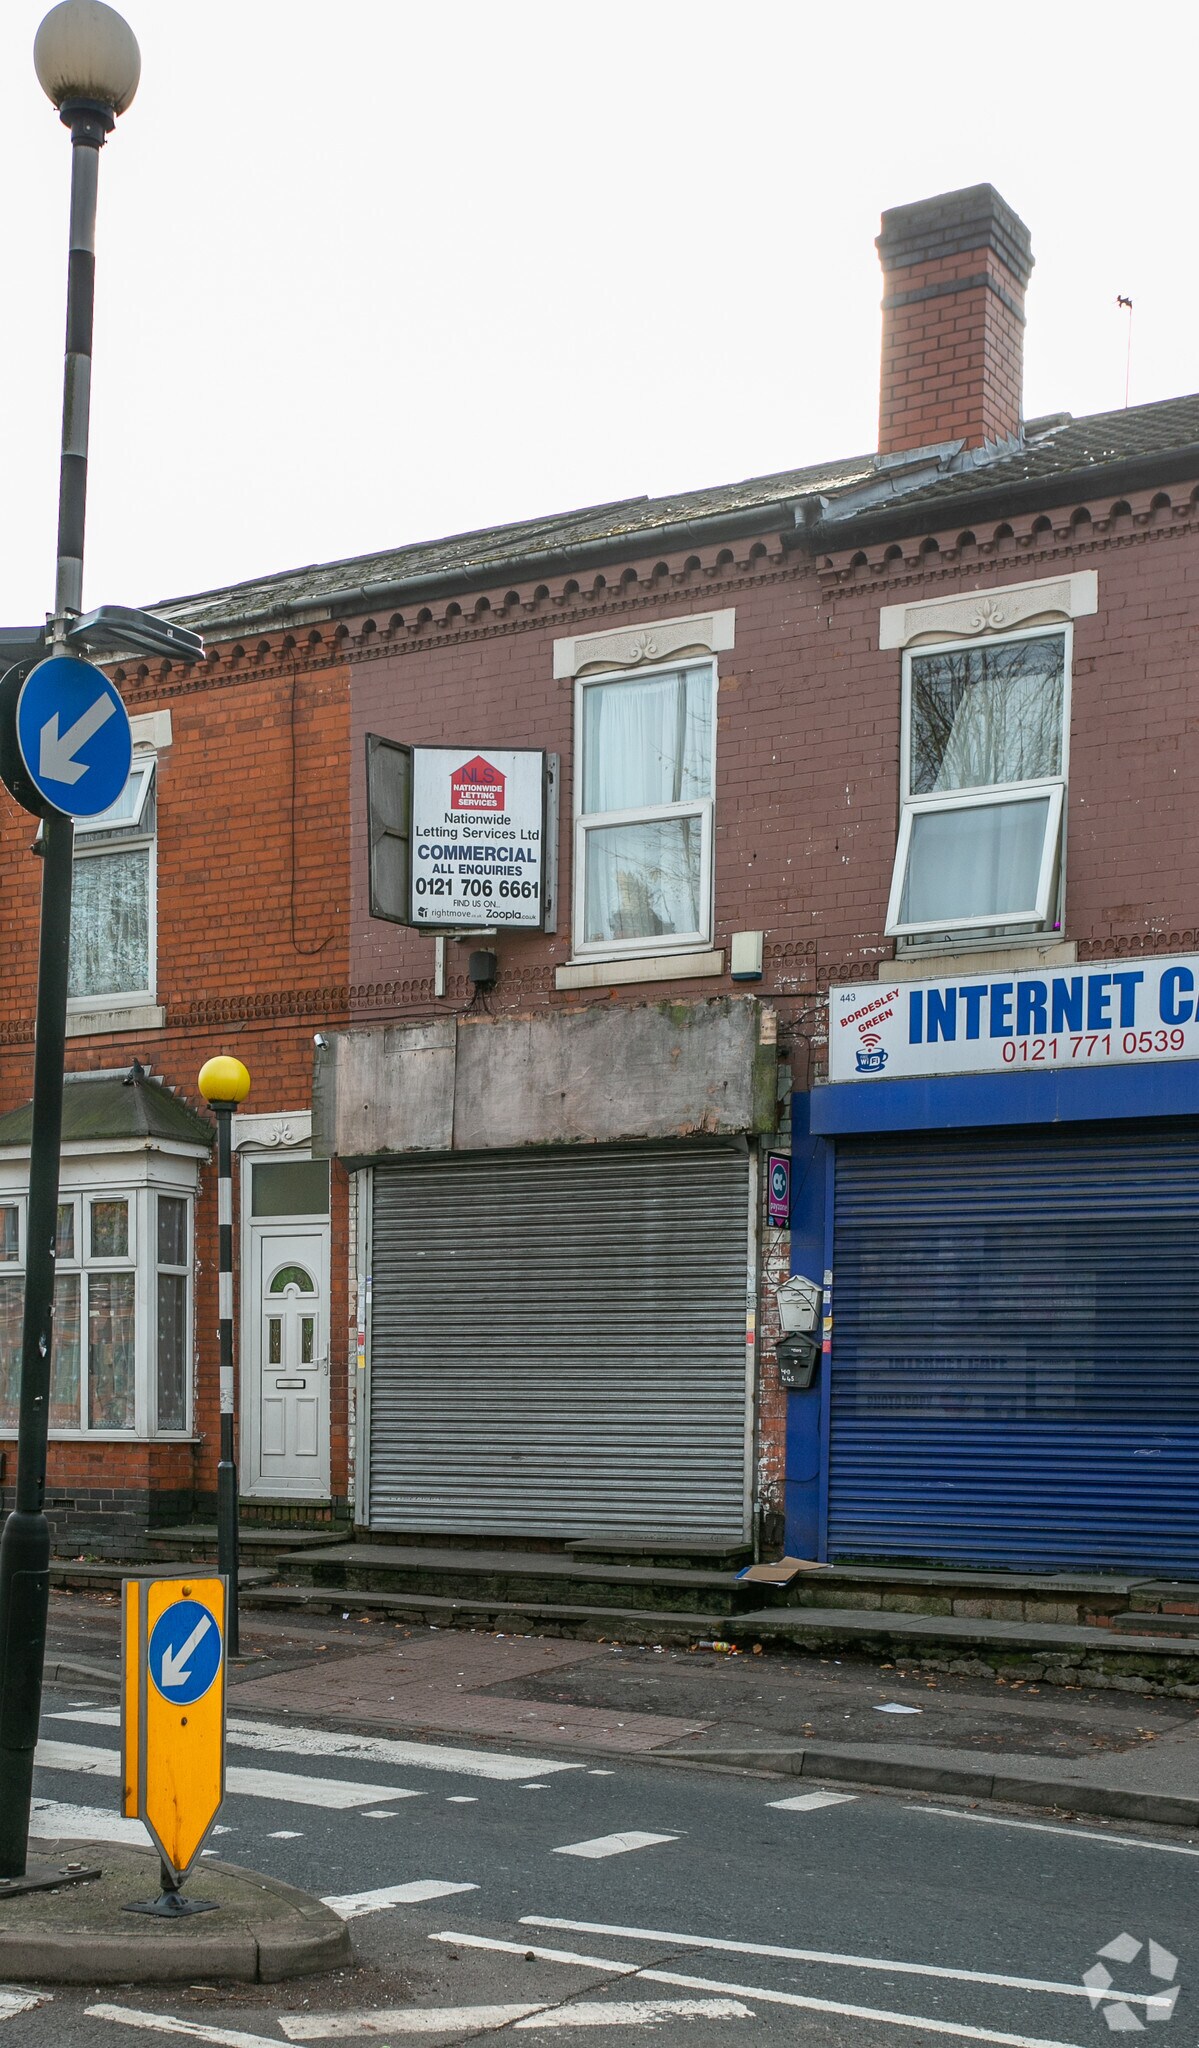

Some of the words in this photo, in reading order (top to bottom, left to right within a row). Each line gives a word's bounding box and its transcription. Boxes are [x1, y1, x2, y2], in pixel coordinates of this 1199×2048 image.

[461, 767, 495, 784] NLS
[453, 784, 503, 793] NATIONWIDE
[460, 792, 496, 800] LETTING
[458, 799, 497, 807] SERVICES
[444, 812, 511, 826] Nationwide
[416, 826, 458, 840] Letting
[462, 827, 516, 840] Services
[520, 829, 540, 841] Ltd
[417, 844, 537, 863] COMMERCIAL
[432, 864, 454, 874] ALL
[458, 864, 523, 877] ENQUIRIES
[415, 877, 453, 896] 0121
[461, 879, 493, 897] 706
[499, 880, 539, 899] 6661
[453, 899, 470, 907] FIND
[472, 900, 481, 908] US
[840, 992, 857, 1003] 443
[908, 971, 1144, 1044] INTERNET
[1159, 966, 1199, 1026] C
[839, 988, 900, 1028] BORDESLEY
[857, 1008, 894, 1033] GREEN
[1002, 1037, 1058, 1063] 0121
[1069, 1034, 1112, 1058] 771
[1122, 1028, 1185, 1055] 0539
